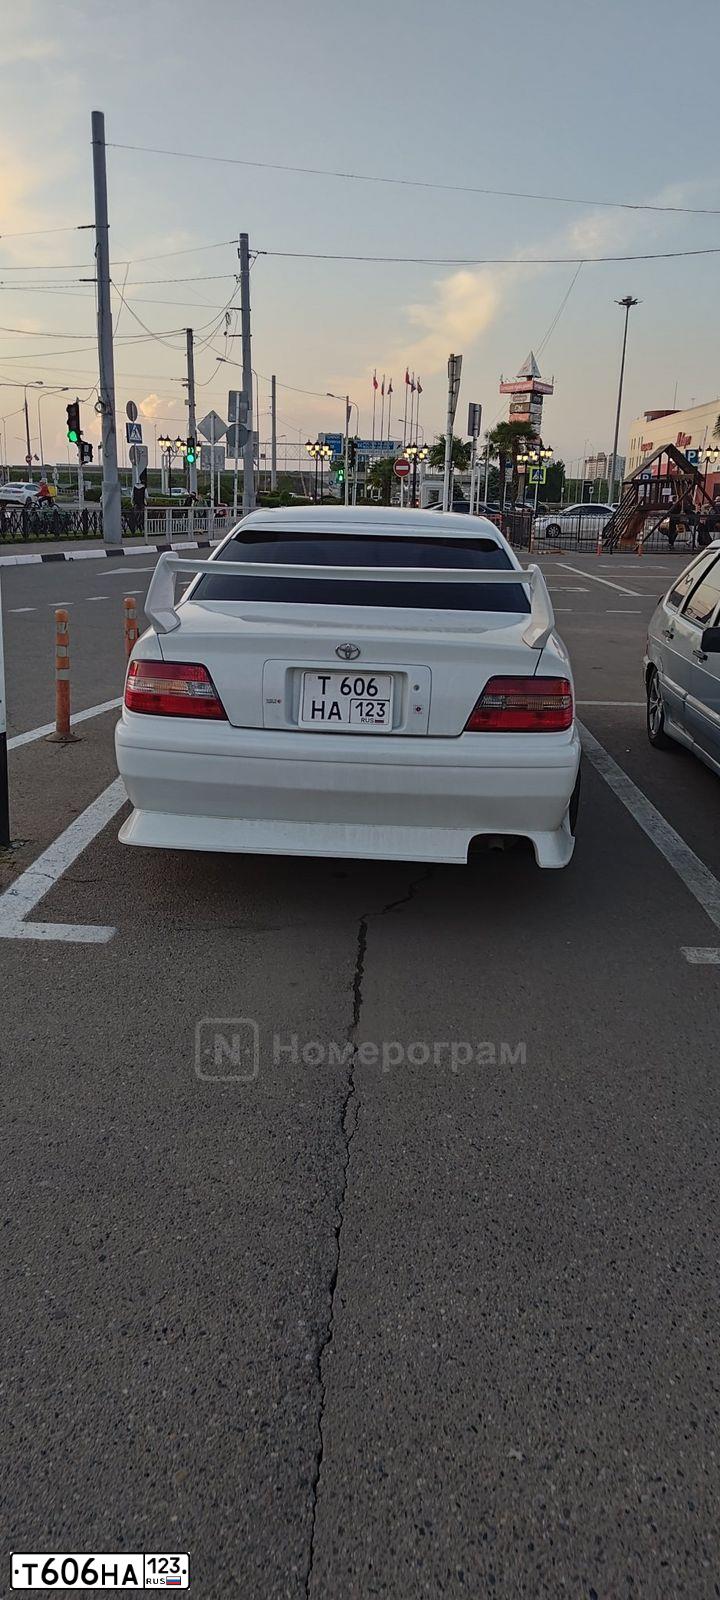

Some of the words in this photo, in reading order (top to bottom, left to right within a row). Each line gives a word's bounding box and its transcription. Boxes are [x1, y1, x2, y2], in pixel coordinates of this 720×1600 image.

[688, 451, 696, 463] P
[317, 675, 331, 695] Т
[340, 677, 379, 697] 606
[311, 700, 342, 720] НА
[355, 702, 386, 717] 123
